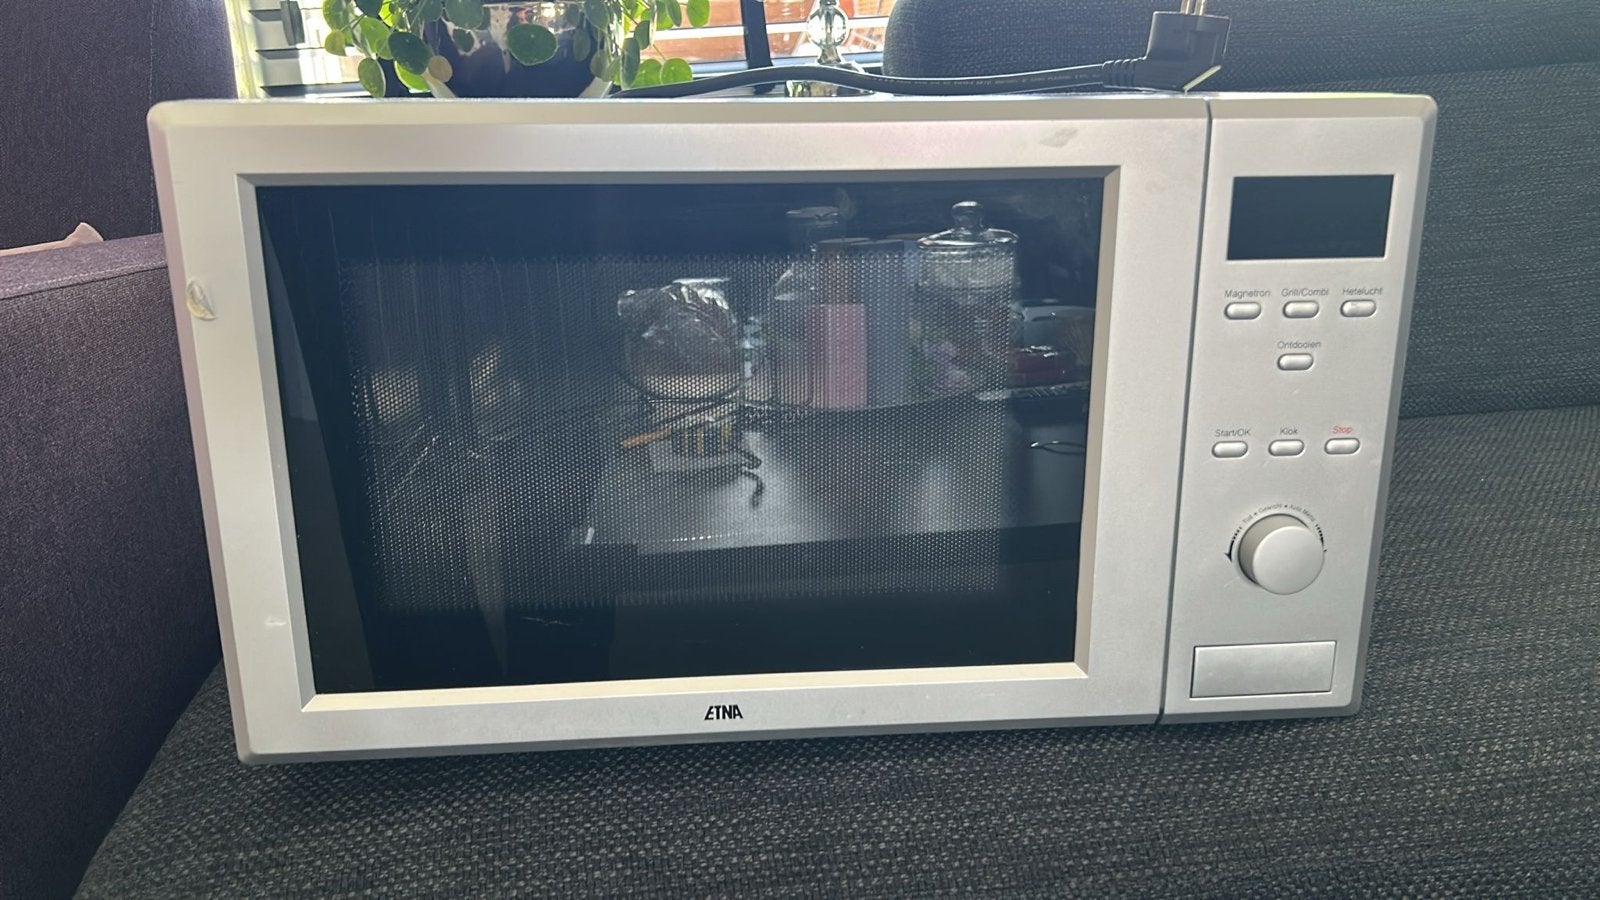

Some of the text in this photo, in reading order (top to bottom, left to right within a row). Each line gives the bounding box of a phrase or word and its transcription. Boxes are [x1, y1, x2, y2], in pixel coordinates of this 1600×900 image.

[1224, 288, 1271, 299] Magnetron
[1215, 428, 1250, 437] Start/OK
[1280, 426, 1299, 435] Klok
[1332, 425, 1353, 435] Stop
[704, 704, 743, 720] ETNA
